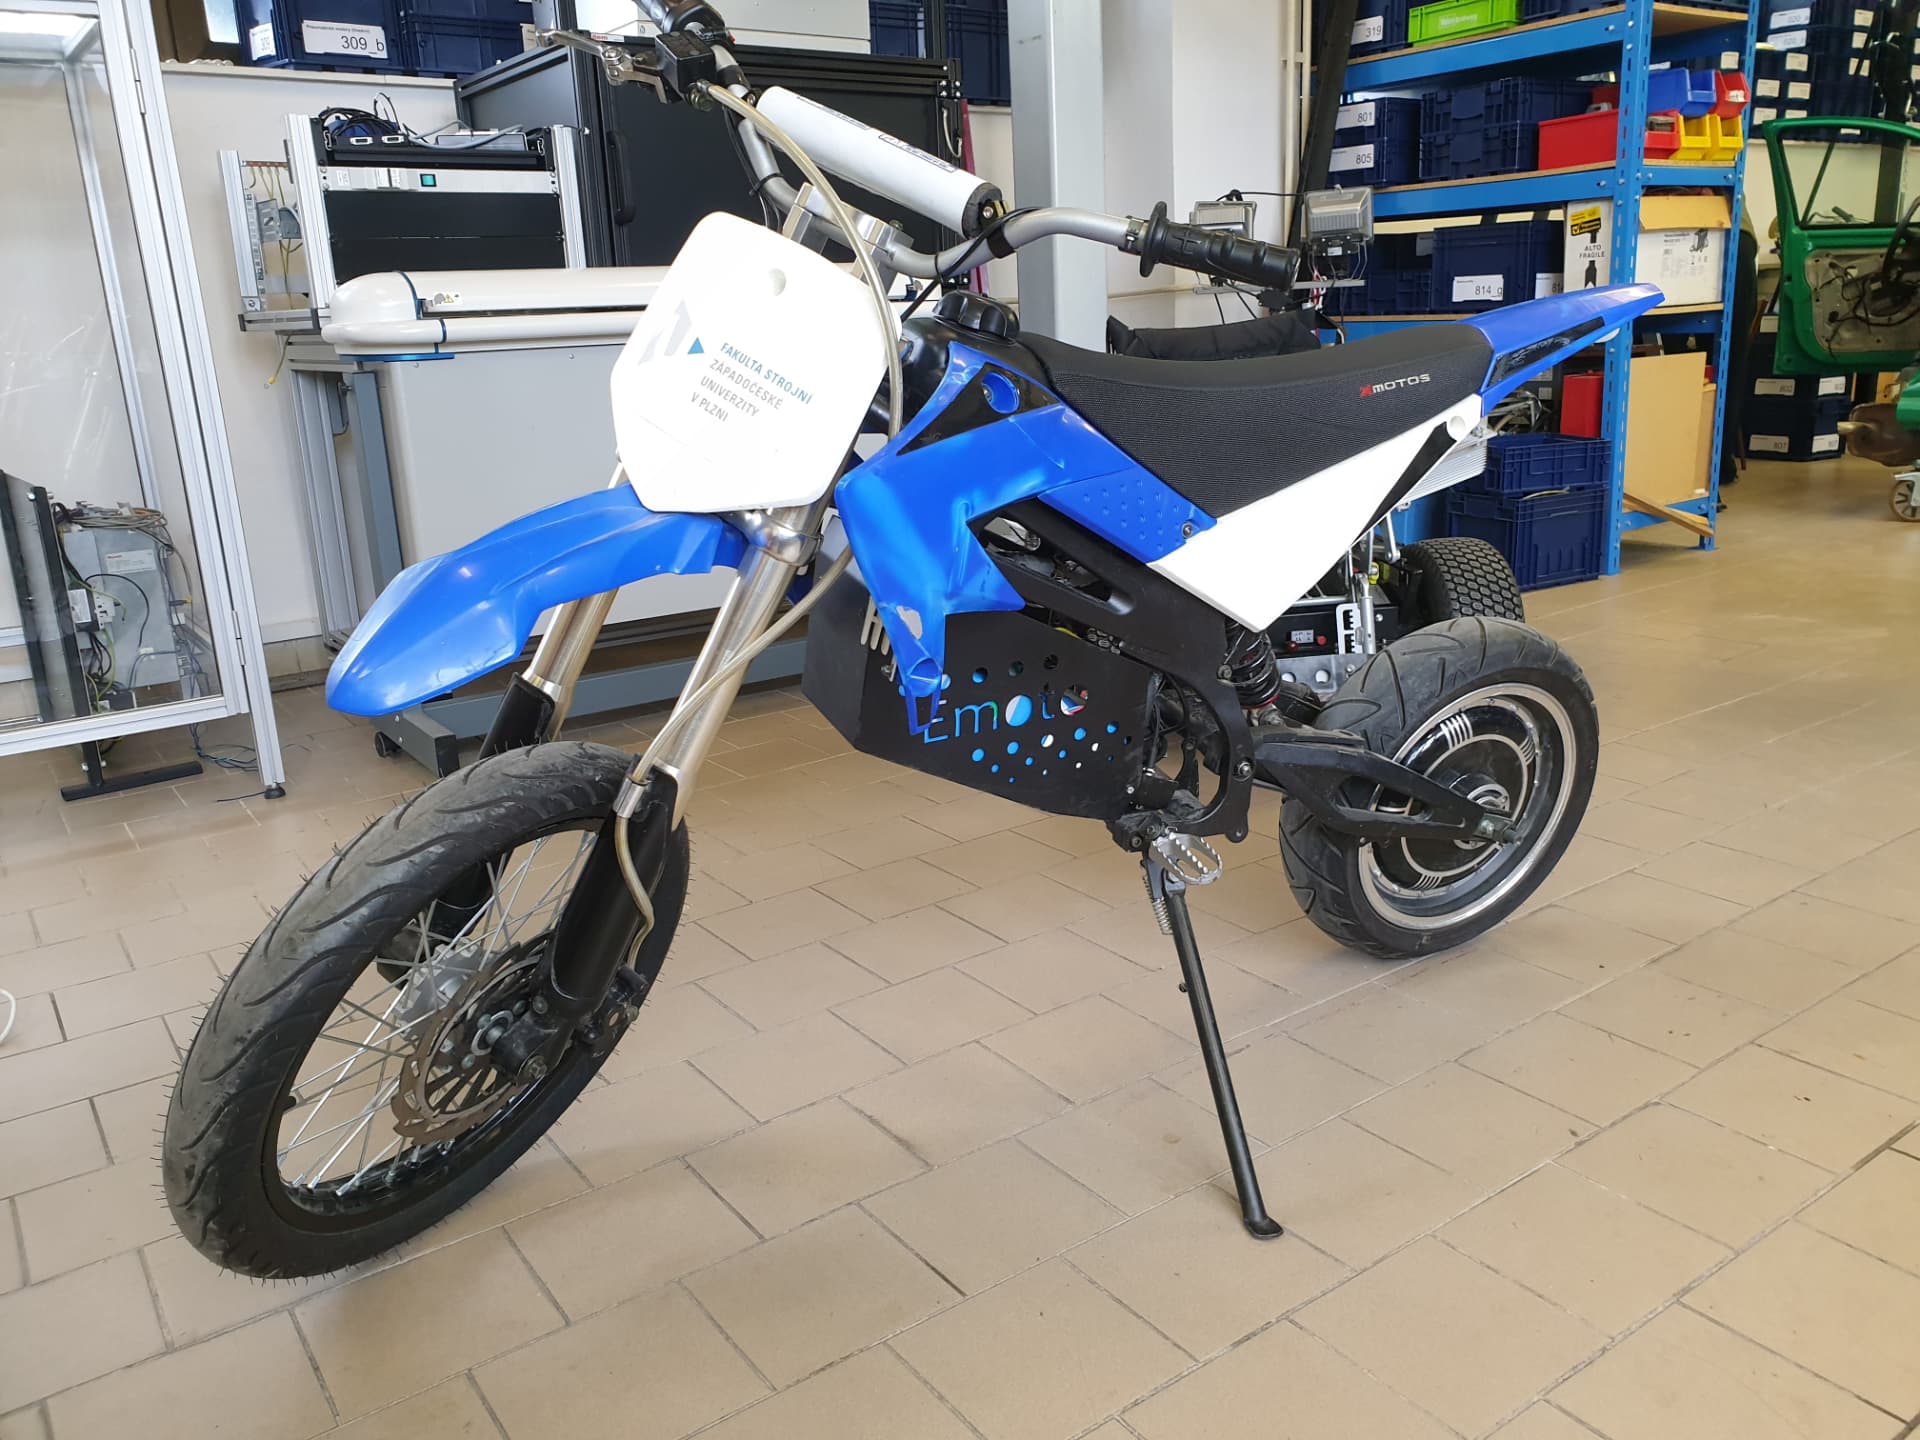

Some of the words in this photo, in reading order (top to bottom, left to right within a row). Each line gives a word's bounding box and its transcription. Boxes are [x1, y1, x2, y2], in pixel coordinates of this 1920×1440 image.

[1366, 25, 1382, 38] 319
[1357, 111, 1373, 123] 801
[1356, 154, 1372, 165] 805
[1584, 244, 1602, 252] ALTO
[1579, 251, 1605, 259] FRAGILE
[720, 342, 763, 375] FAKULTA
[700, 375, 760, 417] UNIVERZITY
[691, 391, 700, 403] V
[699, 397, 729, 422] PLZNI
